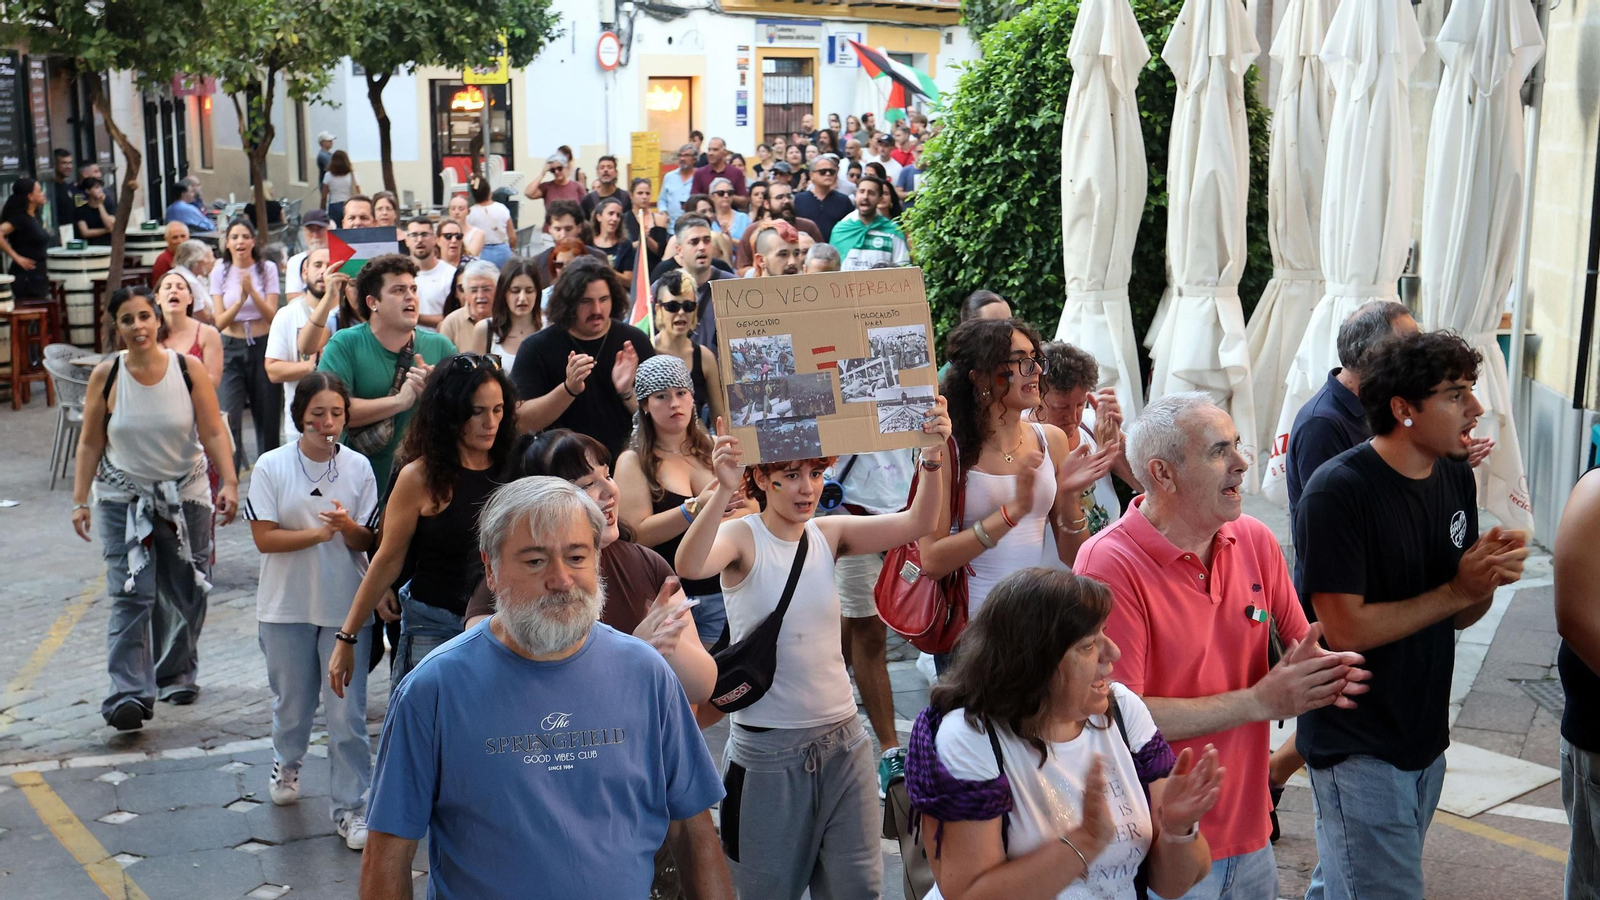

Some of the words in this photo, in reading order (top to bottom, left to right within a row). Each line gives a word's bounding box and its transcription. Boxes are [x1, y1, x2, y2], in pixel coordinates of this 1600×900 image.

[725, 288, 764, 315] NO
[776, 285, 819, 305] VEO
[829, 278, 912, 299] DIFERENCIA
[853, 309, 901, 320] HOLOCAUSTO
[735, 318, 780, 329] GENOCIDIO
[540, 711, 573, 731] The
[485, 727, 626, 755] SPRINGFIELD
[523, 754, 551, 764] GOOD
[554, 752, 575, 763] VIBES
[577, 750, 598, 760] CLUB
[1118, 802, 1133, 817] IS
